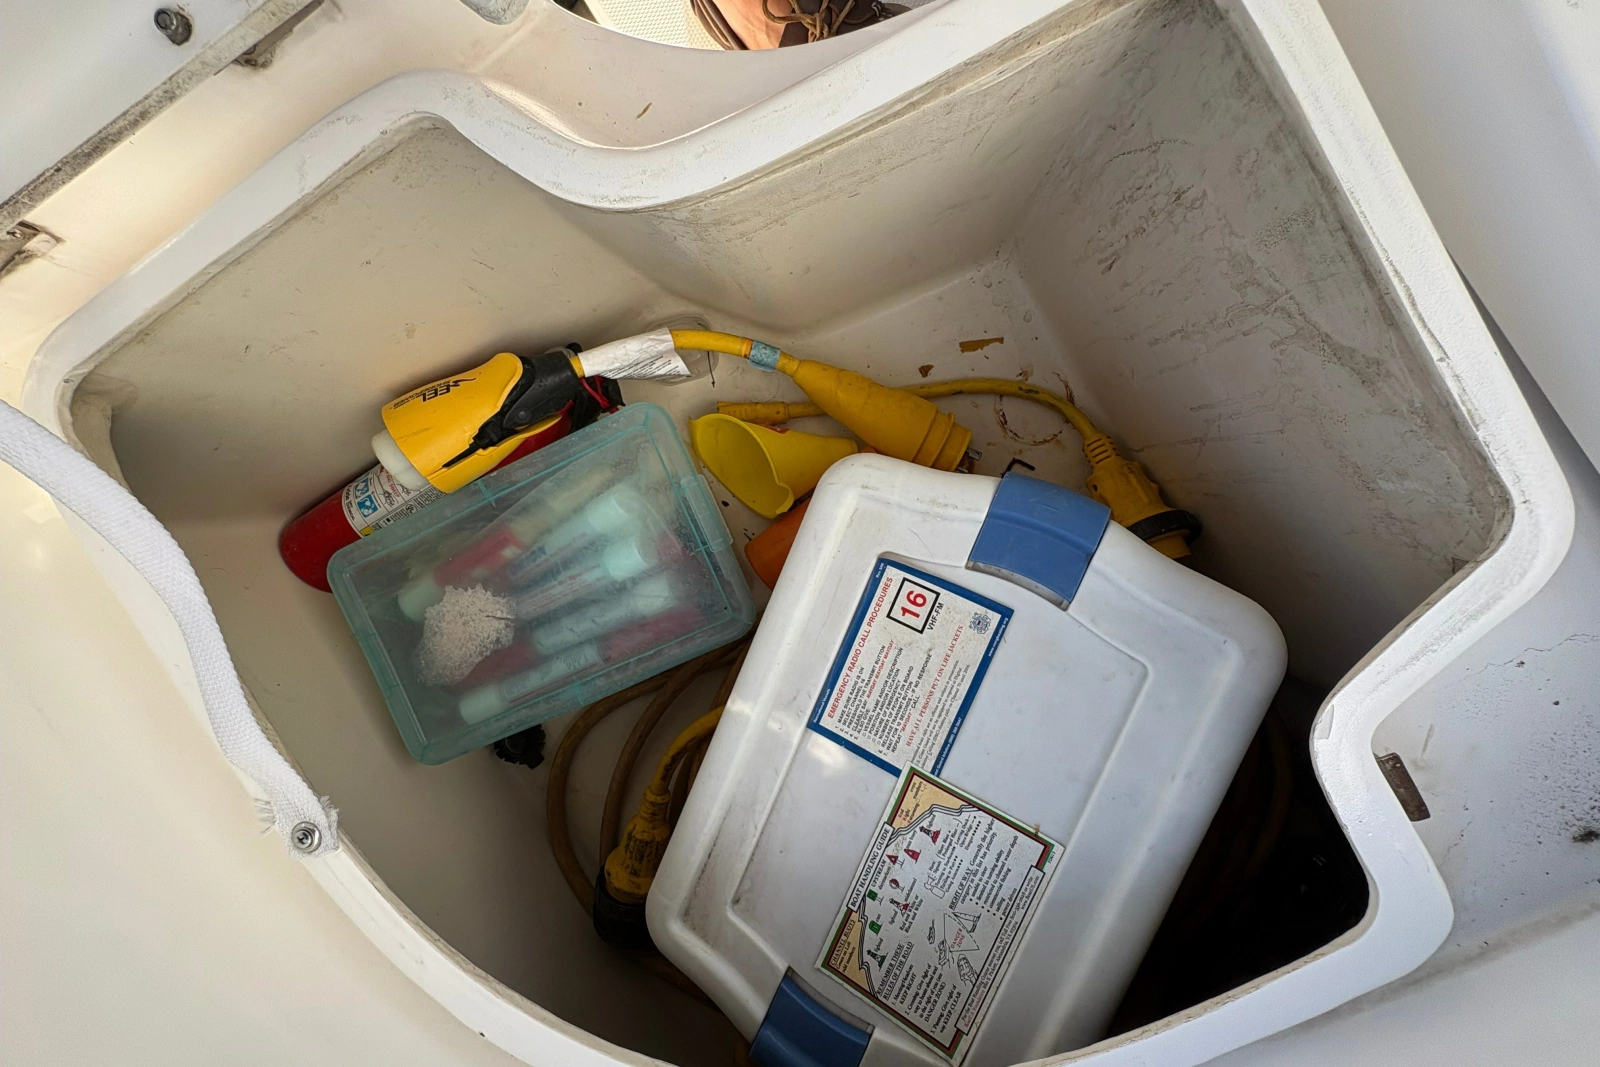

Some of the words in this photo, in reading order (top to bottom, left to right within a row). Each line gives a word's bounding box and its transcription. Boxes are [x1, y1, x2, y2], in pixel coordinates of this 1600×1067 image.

[420, 383, 452, 402] EEL
[898, 588, 928, 622] 16
[926, 601, 944, 631] VHF-FM
[827, 672, 851, 718] EMERGENCY
[847, 648, 862, 672] RADIO
[857, 627, 870, 648] CALL
[866, 576, 893, 627] PROCEDURES
[863, 665, 877, 689] TRANSMIT
[874, 645, 886, 665] BUTTON
[837, 708, 845, 723] MAKE
[843, 695, 851, 709] SURE
[849, 679, 858, 695] RADIO
[858, 666, 864, 674] ON
[841, 707, 853, 726] SELECT
[850, 684, 862, 707] CHANNEL
[851, 709, 864, 731] CLEARLY
[865, 678, 877, 699] MAYDAY
[874, 659, 886, 679] MAYDAY
[883, 639, 895, 659] MAYDAY
[862, 712, 874, 732] VESSEL
[871, 698, 880, 713] NAME
[886, 647, 903, 679] DESCRIPTION
[867, 711, 880, 734] POSITION
[886, 667, 900, 692] LOCATION
[877, 718, 890, 739] NUMBER
[890, 691, 902, 711] PEOPLE
[899, 683, 906, 691] ON
[903, 665, 914, 683] BOARD
[885, 738, 894, 750] WAIT
[891, 727, 899, 738] FOR
[898, 697, 912, 721] SECONDS
[913, 680, 920, 688] NO
[917, 653, 932, 680] RESPONSE
[904, 729, 916, 746] HAVE
[912, 716, 922, 729] ALL
[918, 689, 934, 717] PERSONS
[930, 676, 940, 690] PUT
[936, 667, 945, 677] ON
[941, 652, 952, 667] LIFE
[947, 625, 965, 653] JACKETS
[856, 720, 865, 734] ALSO
[873, 717, 884, 737] NATURE
[885, 679, 901, 710] EMERGENCY
[880, 724, 893, 747] RELEASE
[890, 701, 904, 725] TRANSMIT
[901, 680, 913, 701] BUTTON
[890, 733, 902, 753] REPEAT
[911, 779, 923, 799] numbers
[850, 887, 862, 907] BOAT
[858, 850, 879, 888] HANDLING
[875, 827, 890, 851] GUIDE
[871, 859, 886, 887] UPSTREAM
[948, 889, 961, 910] RIGHT
[957, 881, 965, 891] OF
[961, 866, 972, 882] WAY
[968, 842, 984, 867] Generally
[979, 833, 987, 842] the
[983, 817, 996, 834] higher
[970, 882, 980, 897] unable
[979, 865, 988, 877] steer
[975, 884, 987, 901] limited
[986, 862, 998, 880] turning
[993, 848, 1005, 863] ability
[981, 883, 995, 905] restricted
[994, 860, 1006, 879] channel
[1003, 847, 1012, 861] water
[1008, 834, 1020, 849] depth
[959, 883, 973, 904] category
[971, 867, 979, 878] this
[987, 882, 1003, 908] commercial
[999, 866, 1011, 883] fishing
[994, 896, 1005, 912] sailing
[1000, 901, 1011, 916] power
[1007, 887, 1017, 902] driven
[830, 938, 845, 966] CHANNEL
[843, 918, 854, 937] BUOYS
[949, 927, 963, 949] DANGER
[956, 934, 965, 948] ZONE
[875, 961, 894, 995] REMEMBER
[890, 942, 903, 962] THESE
[882, 979, 895, 999] RULES
[891, 971, 898, 981] OF
[895, 958, 905, 971] THE
[901, 940, 913, 959] ROAD
[898, 989, 908, 1004] KEEP
[905, 972, 917, 990] RIGHT
[923, 998, 938, 1022] DANGER
[942, 1009, 953, 1025] KEEP
[949, 990, 962, 1010] CLEAR
